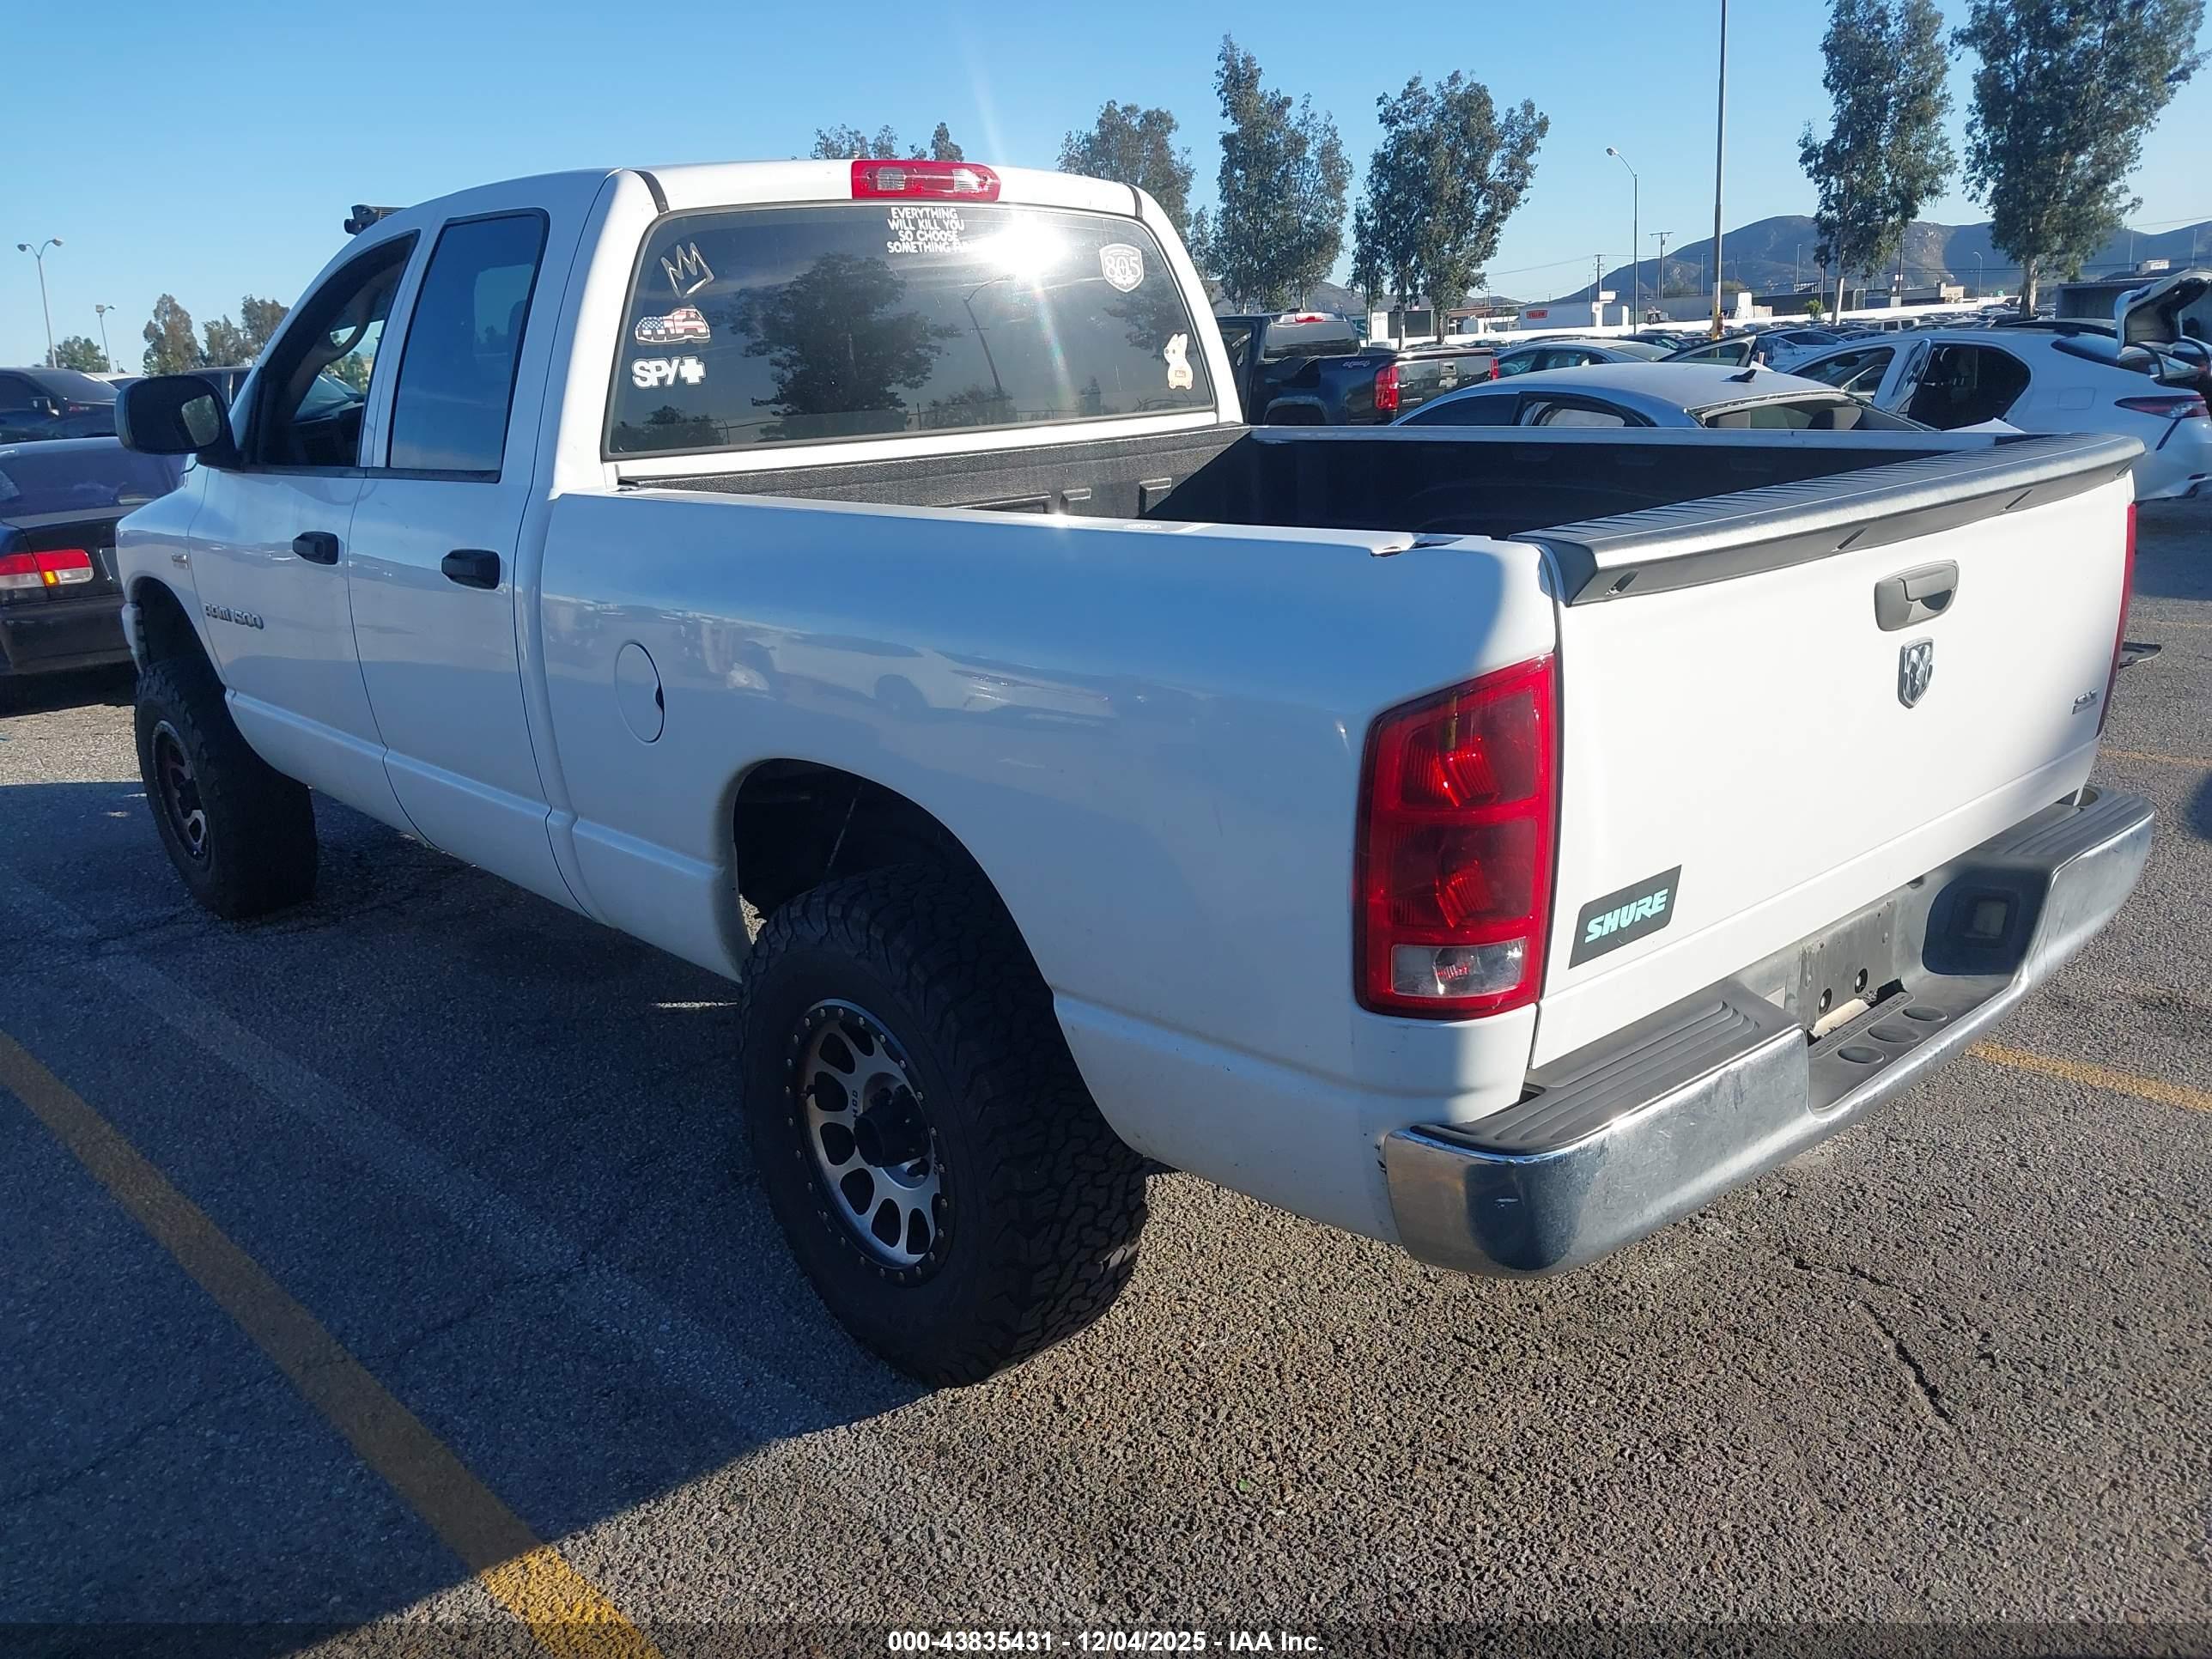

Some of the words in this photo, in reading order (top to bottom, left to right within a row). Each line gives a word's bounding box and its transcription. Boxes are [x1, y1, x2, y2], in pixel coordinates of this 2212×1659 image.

[890, 207, 958, 219] EVERYTHING
[887, 219, 915, 230] WILL
[917, 219, 940, 230] KILL
[943, 219, 965, 231] YOU
[898, 230, 914, 241] SO
[916, 230, 959, 242] CHOOSE
[886, 241, 951, 253] SOMETHING
[1105, 255, 1141, 278] 805
[1584, 888, 1668, 944] SHURE
